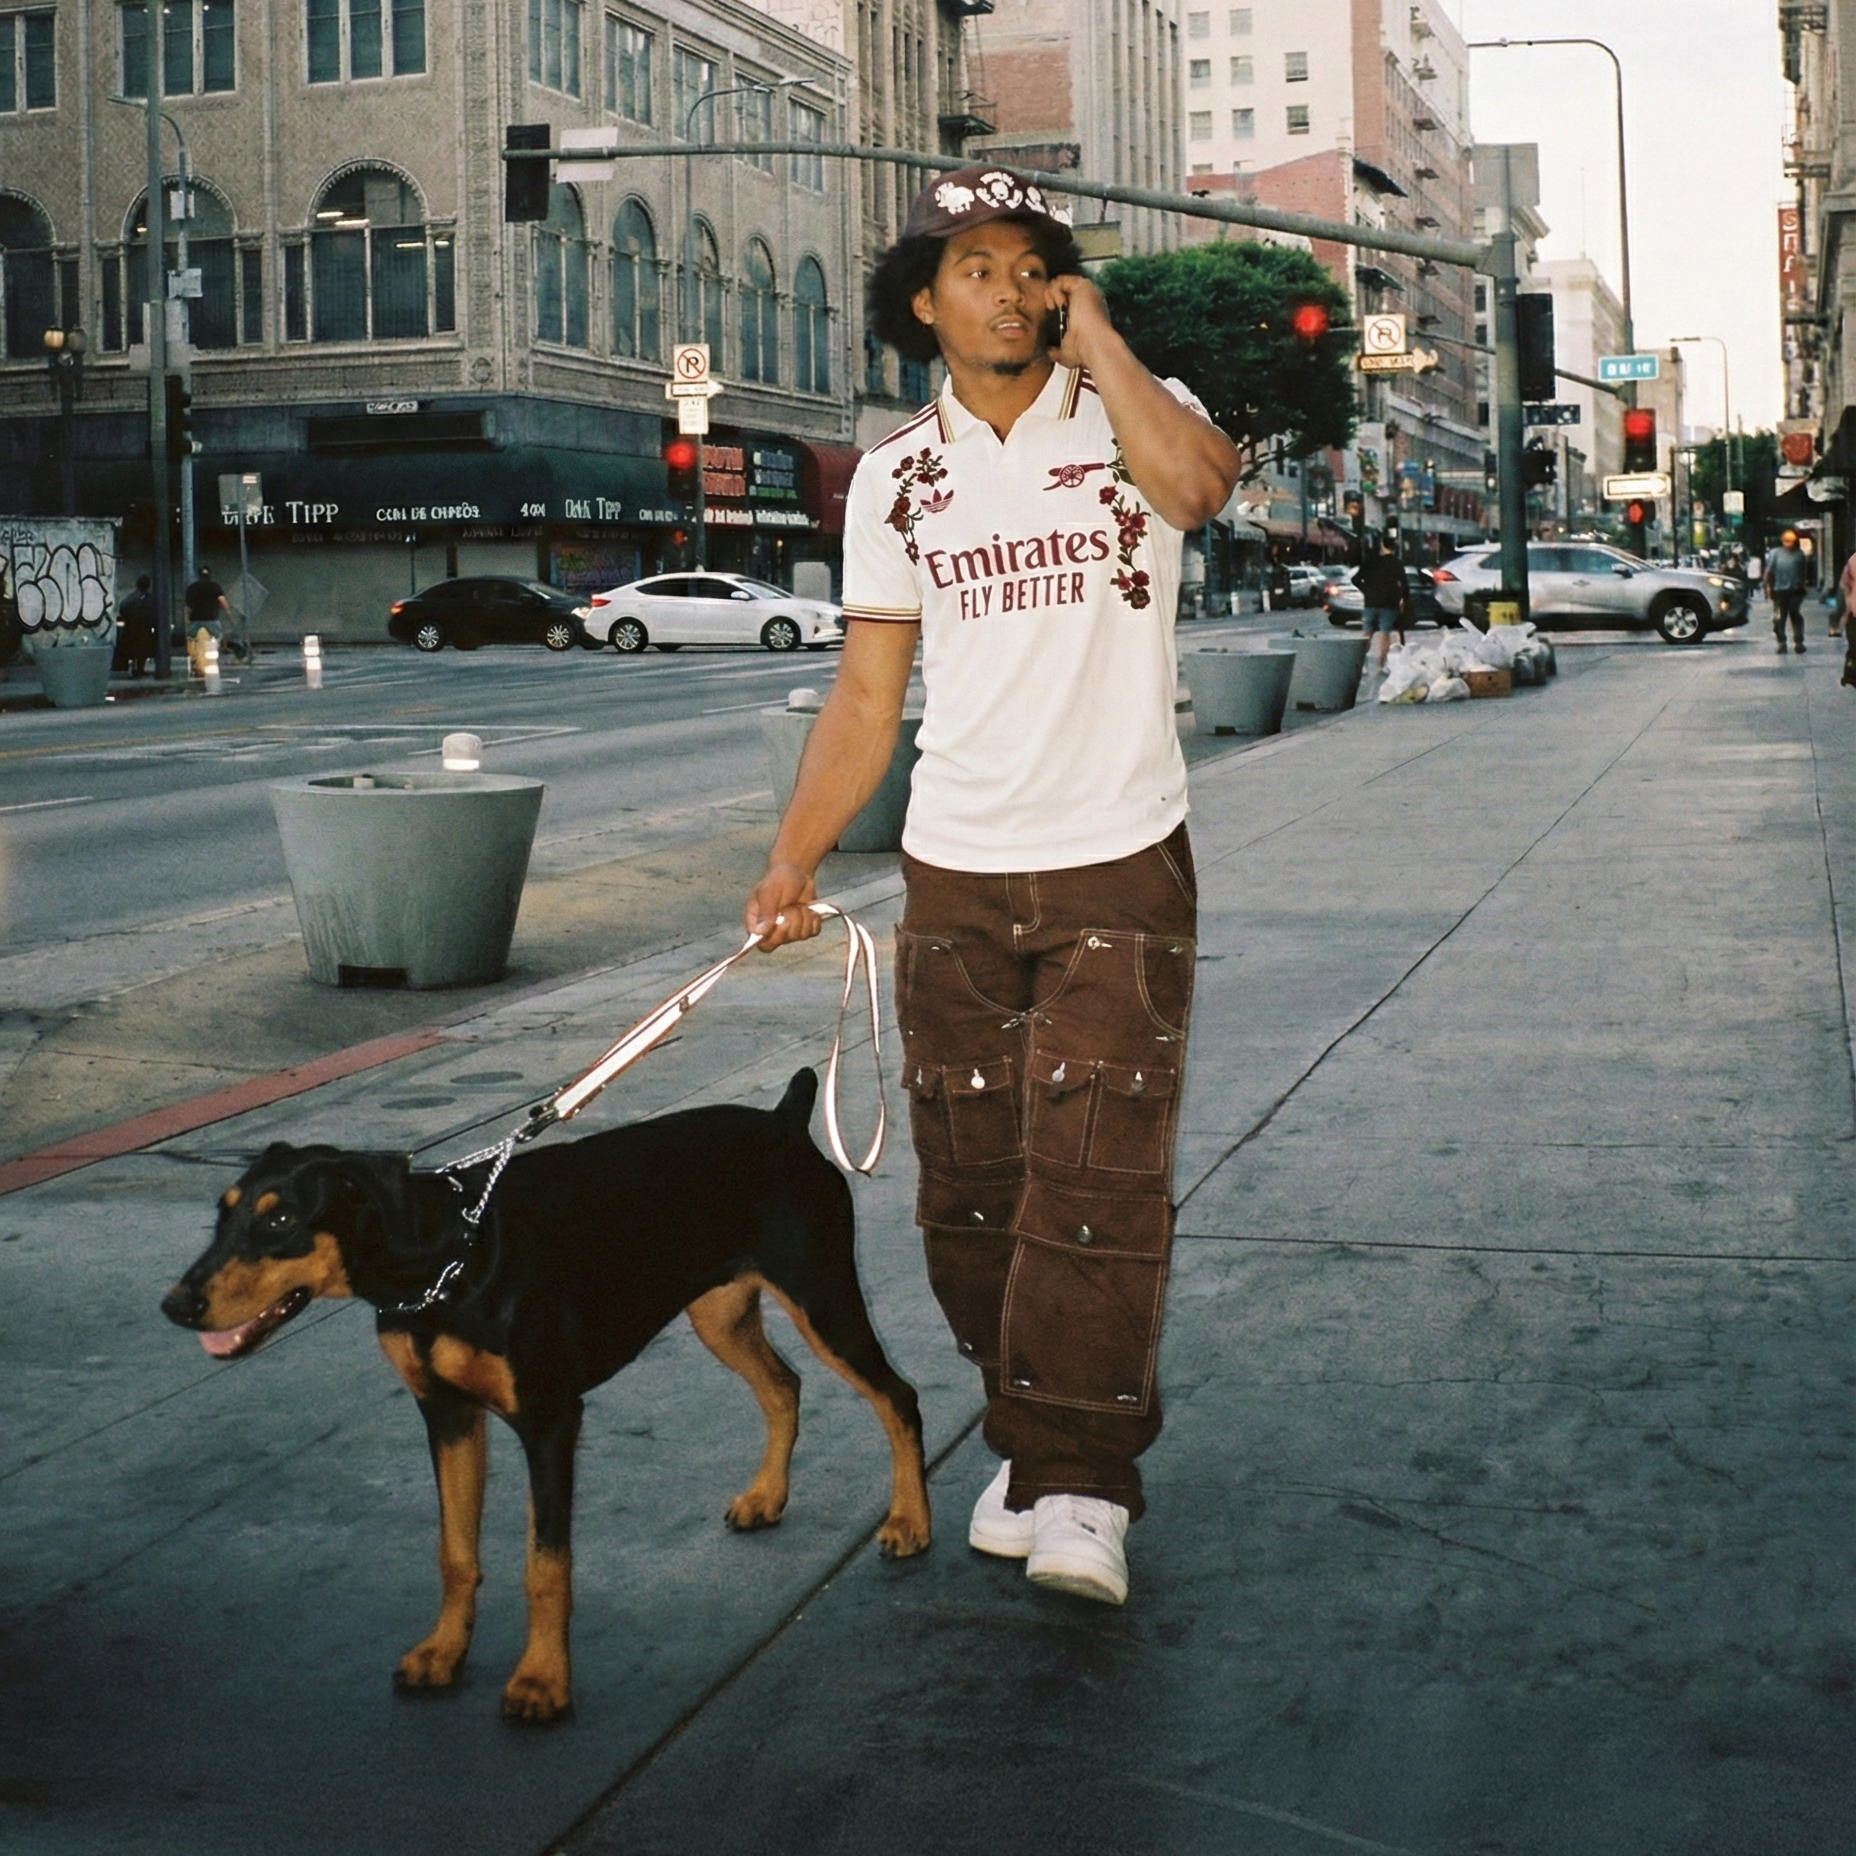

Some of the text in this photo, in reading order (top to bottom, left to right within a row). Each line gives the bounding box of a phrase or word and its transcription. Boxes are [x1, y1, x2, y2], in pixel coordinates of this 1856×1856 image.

[285, 501, 339, 524] TIPP
[924, 529, 1110, 589] Emirates
[960, 572, 1084, 621] FLY BETTER
